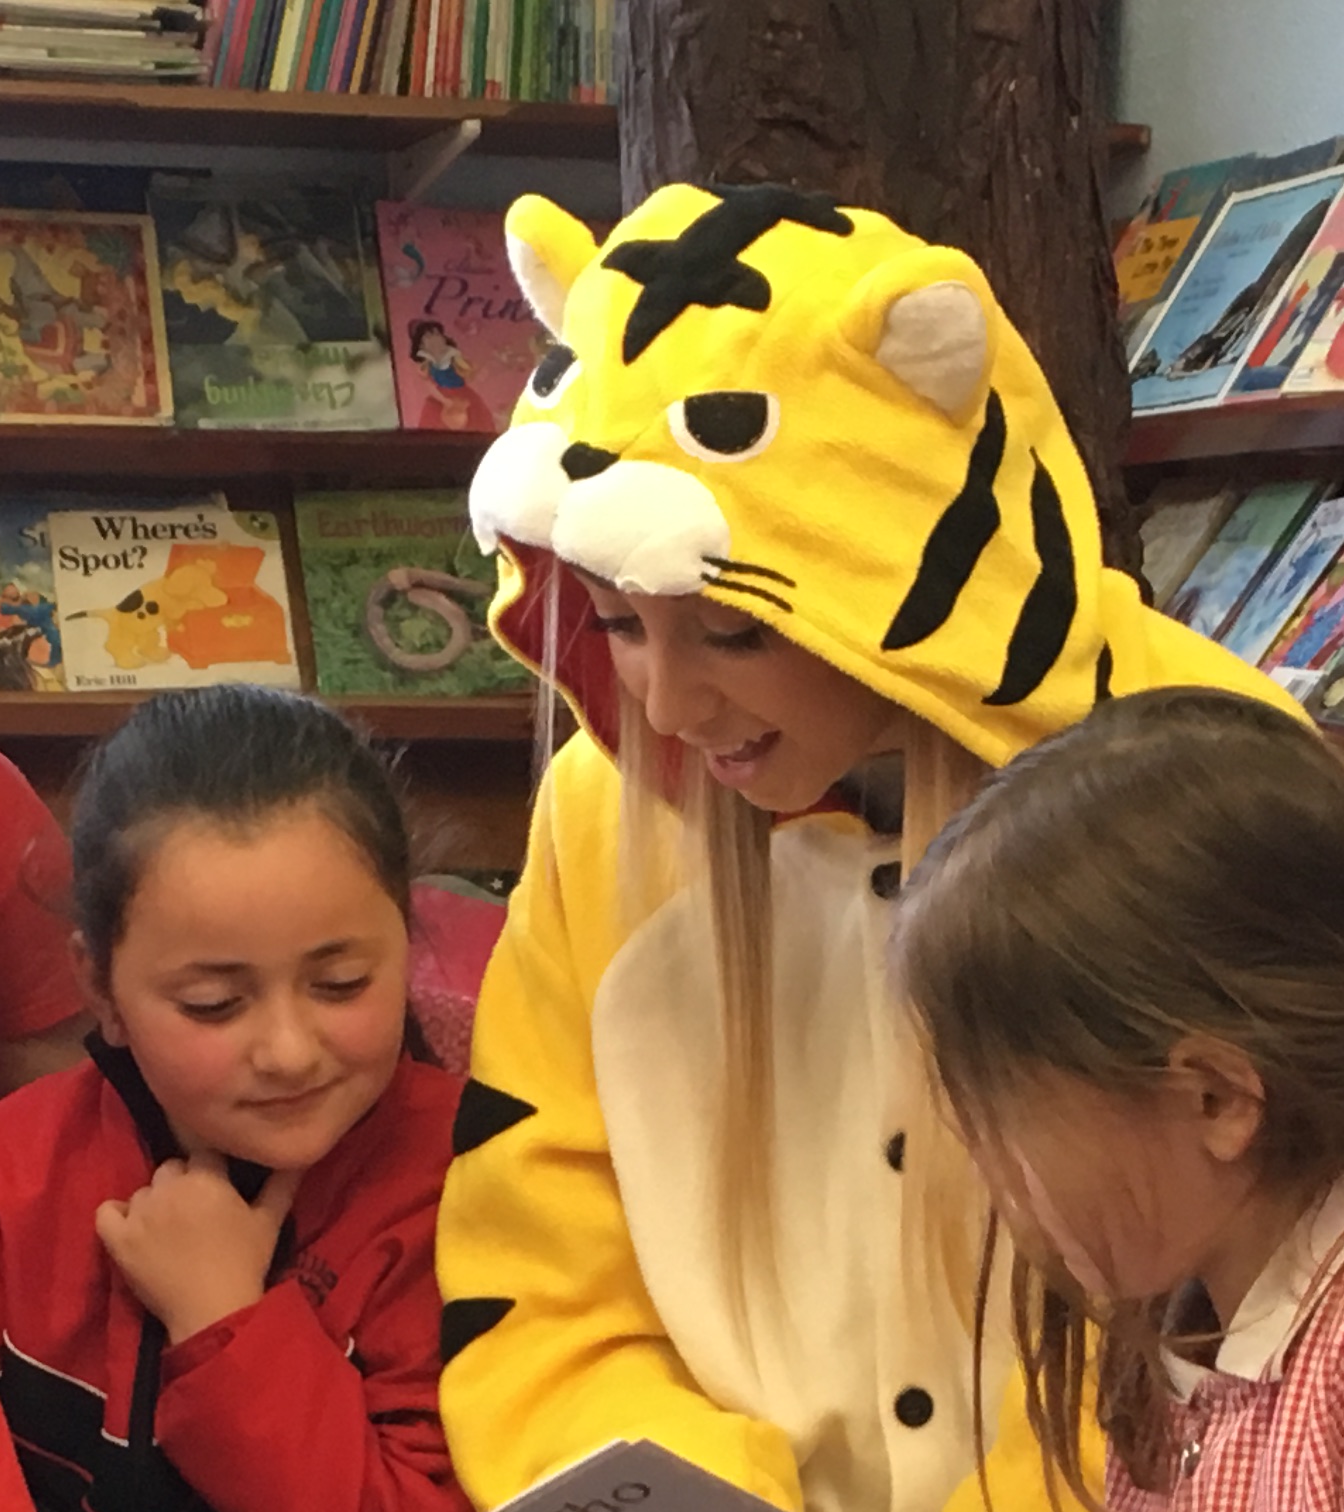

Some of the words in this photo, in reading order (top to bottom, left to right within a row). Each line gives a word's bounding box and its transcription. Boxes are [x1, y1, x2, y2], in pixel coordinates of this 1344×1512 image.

[425, 272, 536, 323] Prin
[91, 513, 218, 541] Where's
[58, 544, 147, 577] Spot?
[75, 674, 105, 688] Eric
[109, 673, 137, 687] Hill
